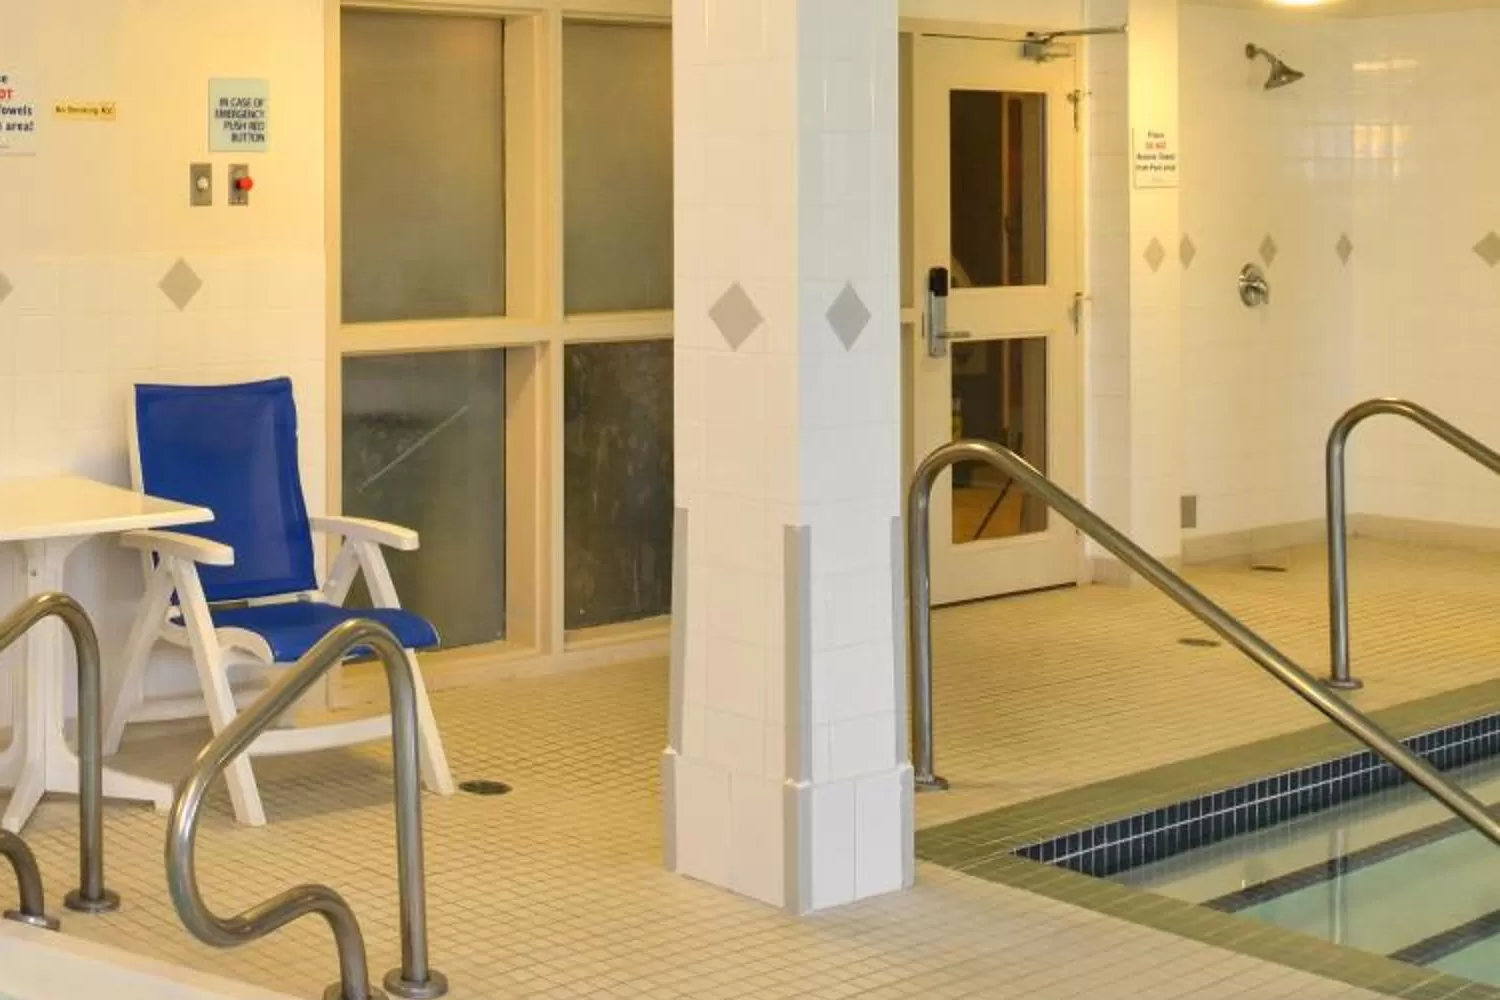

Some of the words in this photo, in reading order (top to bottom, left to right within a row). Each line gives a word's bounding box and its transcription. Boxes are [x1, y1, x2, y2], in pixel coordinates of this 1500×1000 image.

[219, 97, 229, 107] IN
[230, 97, 251, 107] CASE
[214, 108, 265, 119] EMERGENCY
[5, 121, 34, 132] area!
[223, 120, 247, 131] PUSH
[231, 132, 265, 143] BUTTON
